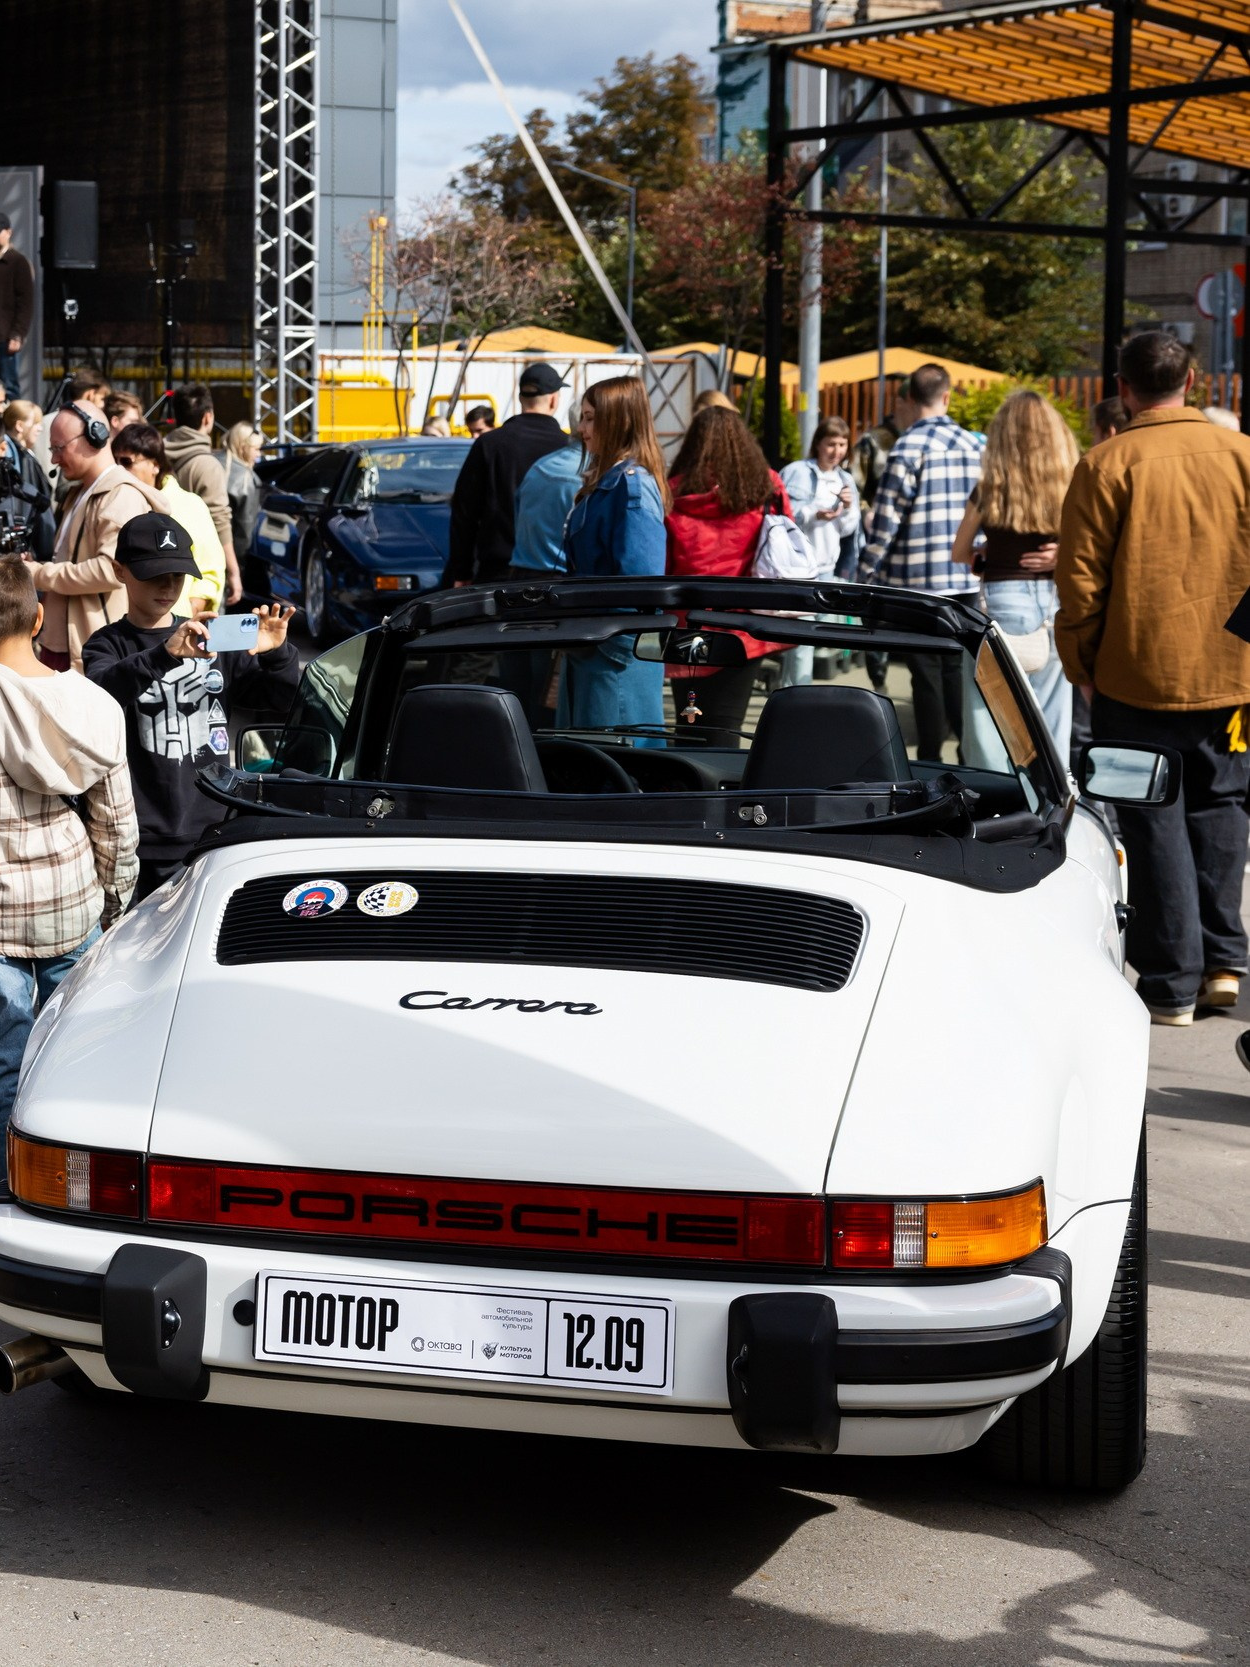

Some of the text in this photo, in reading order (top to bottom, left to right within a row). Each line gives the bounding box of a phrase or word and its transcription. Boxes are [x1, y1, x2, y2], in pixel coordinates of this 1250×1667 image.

[399, 990, 603, 1016] Carrera
[219, 1184, 739, 1246] PORSCHE
[280, 1289, 400, 1352] МОТОР
[481, 1313, 533, 1323] автомобильной
[496, 1307, 533, 1316] Фестиваль
[502, 1322, 533, 1331] культуры
[500, 1345, 532, 1353] КУЛЬТУРА
[562, 1312, 644, 1373] 12.09
